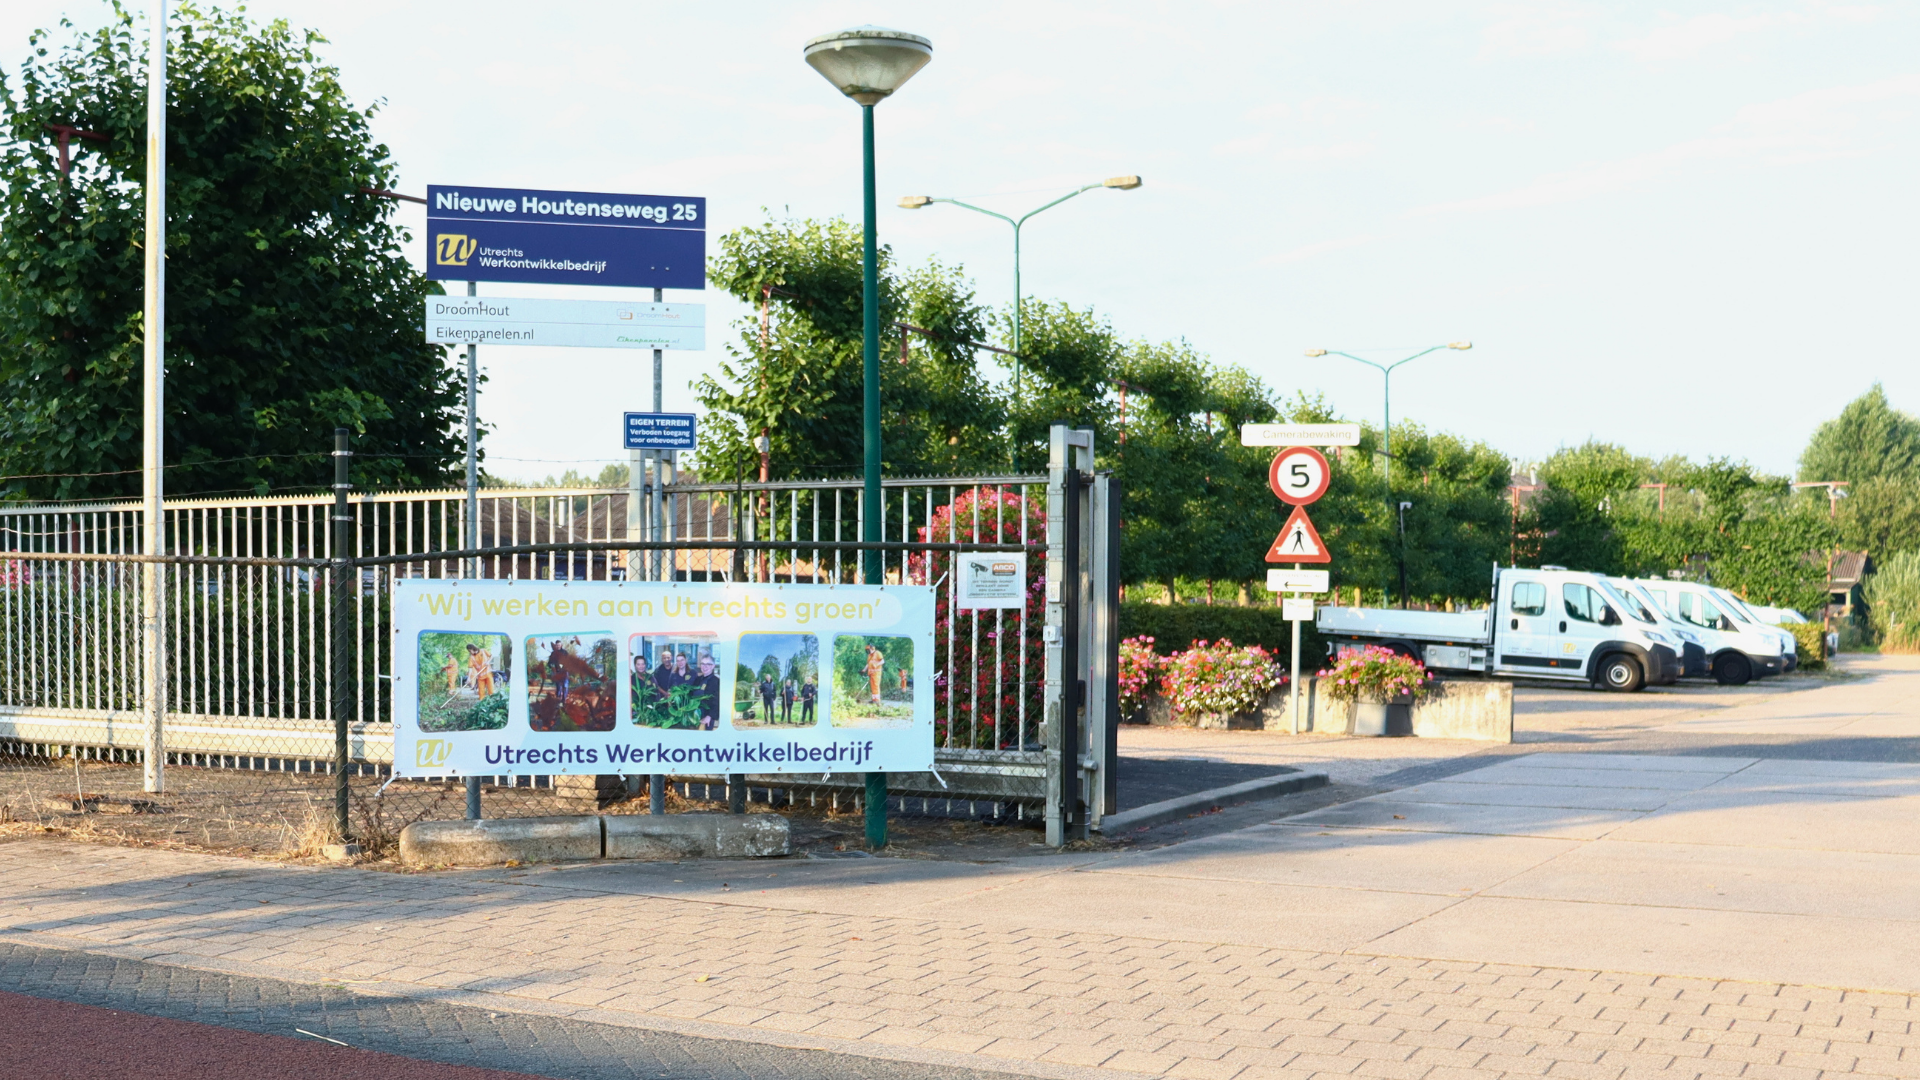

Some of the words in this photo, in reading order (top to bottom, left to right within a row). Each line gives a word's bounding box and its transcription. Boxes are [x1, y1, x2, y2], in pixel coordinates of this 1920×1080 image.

[436, 192, 517, 213] Nieuwe
[522, 196, 668, 224] Houtenseweg
[672, 203, 698, 221] 25
[479, 247, 524, 258] Utrechts
[479, 257, 607, 274] Werkontwikkelbedrijf
[435, 303, 510, 317] DroomHout
[436, 327, 535, 343] Eikenpanelen.nl
[630, 418, 654, 426] EIGEN
[655, 419, 690, 427] TERREIN
[663, 429, 690, 437] toegang
[1262, 430, 1352, 440] Camerabewaking
[646, 437, 691, 445] onbevoegden
[1290, 464, 1310, 488] 5
[482, 593, 588, 616] werken
[598, 599, 653, 616] aan
[663, 595, 787, 618] Utrechts
[485, 743, 598, 764] Utrechts
[605, 740, 874, 765] Werkontwikkelbedrijf
